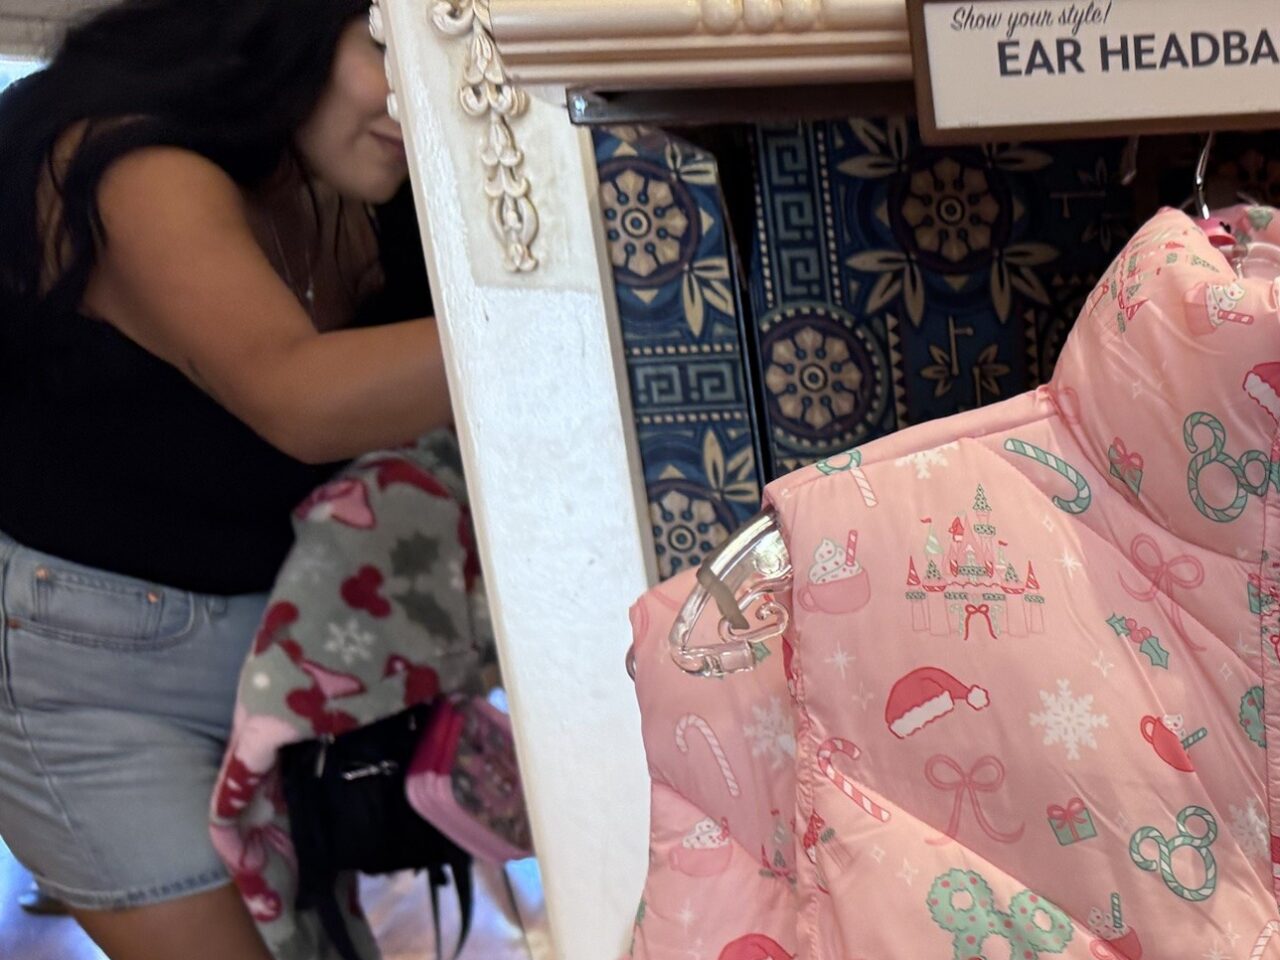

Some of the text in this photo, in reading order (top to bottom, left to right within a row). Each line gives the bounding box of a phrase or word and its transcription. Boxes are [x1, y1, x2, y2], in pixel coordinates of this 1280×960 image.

[950, 0, 1113, 39] Show your style!
[997, 38, 1085, 78] EAR
